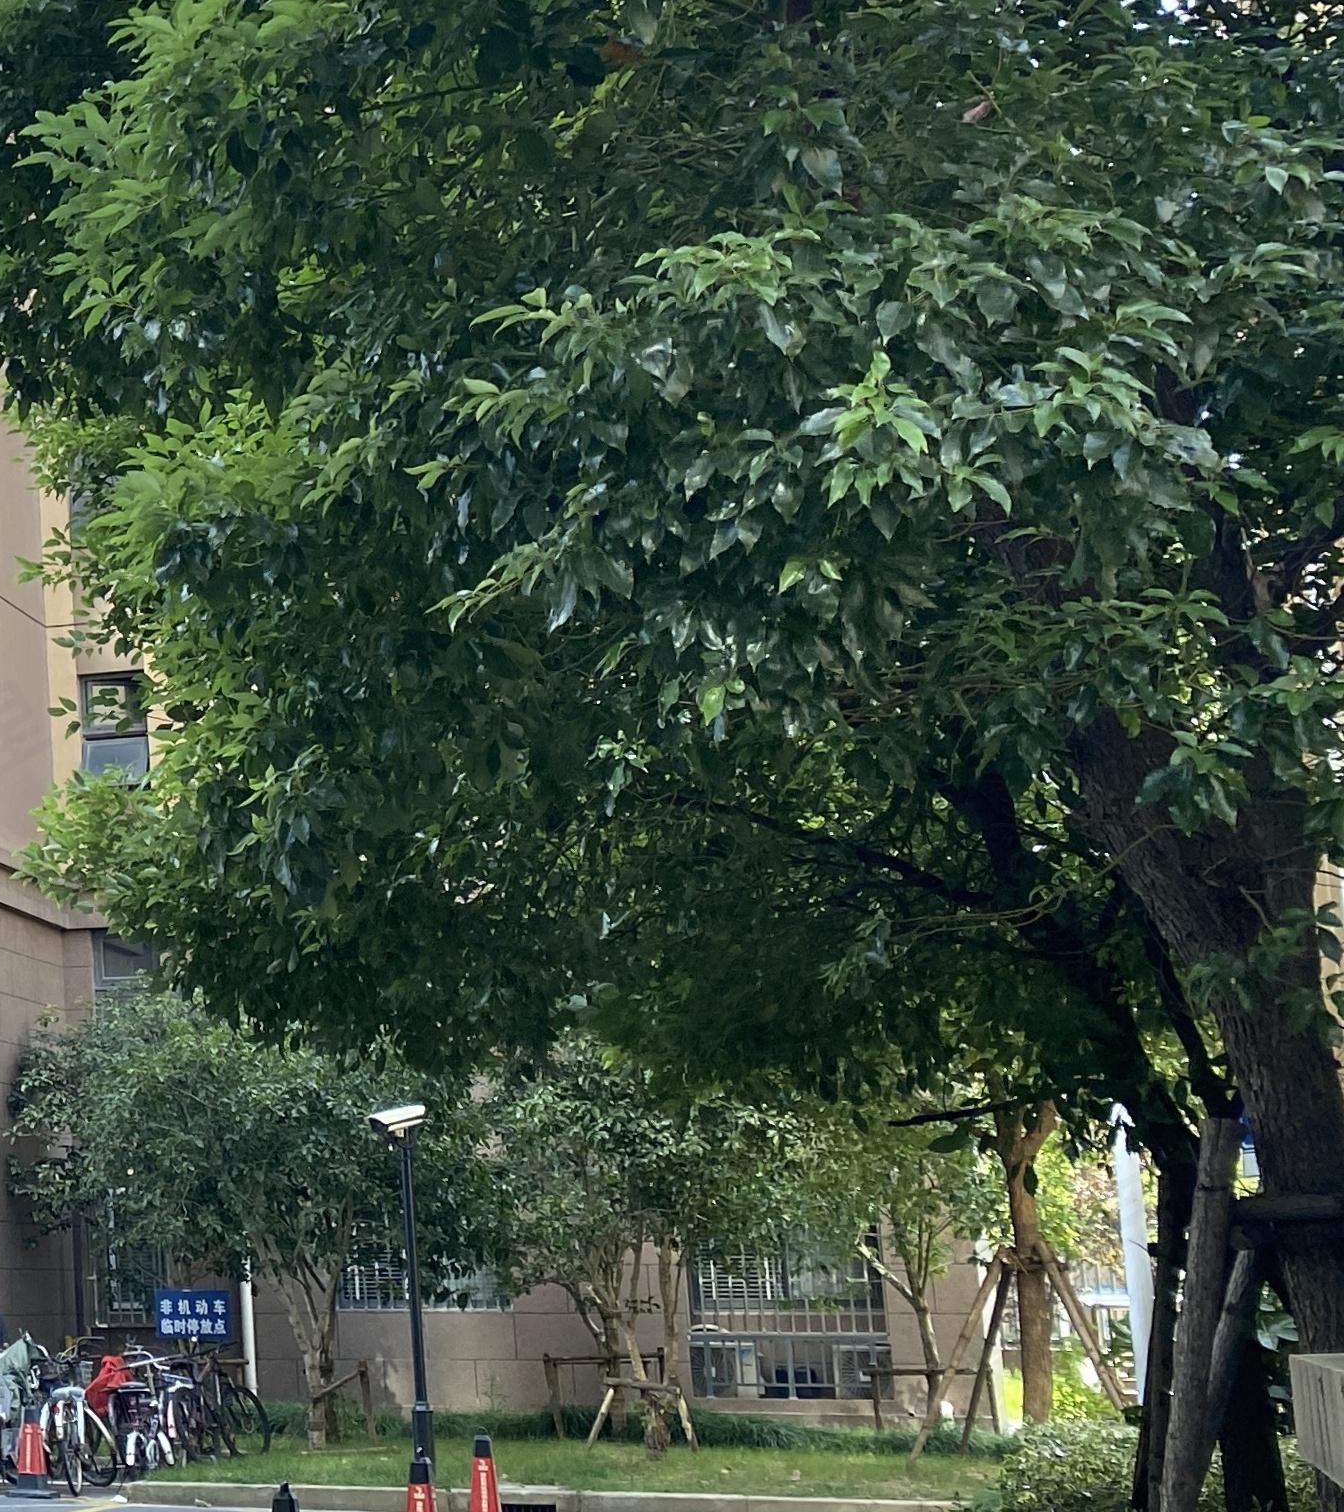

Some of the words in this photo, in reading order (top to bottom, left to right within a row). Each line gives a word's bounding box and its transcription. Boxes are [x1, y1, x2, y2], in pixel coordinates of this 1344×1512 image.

[160, 1299, 226, 1315] 非机动车
[161, 1318, 227, 1335] 临时停放点
